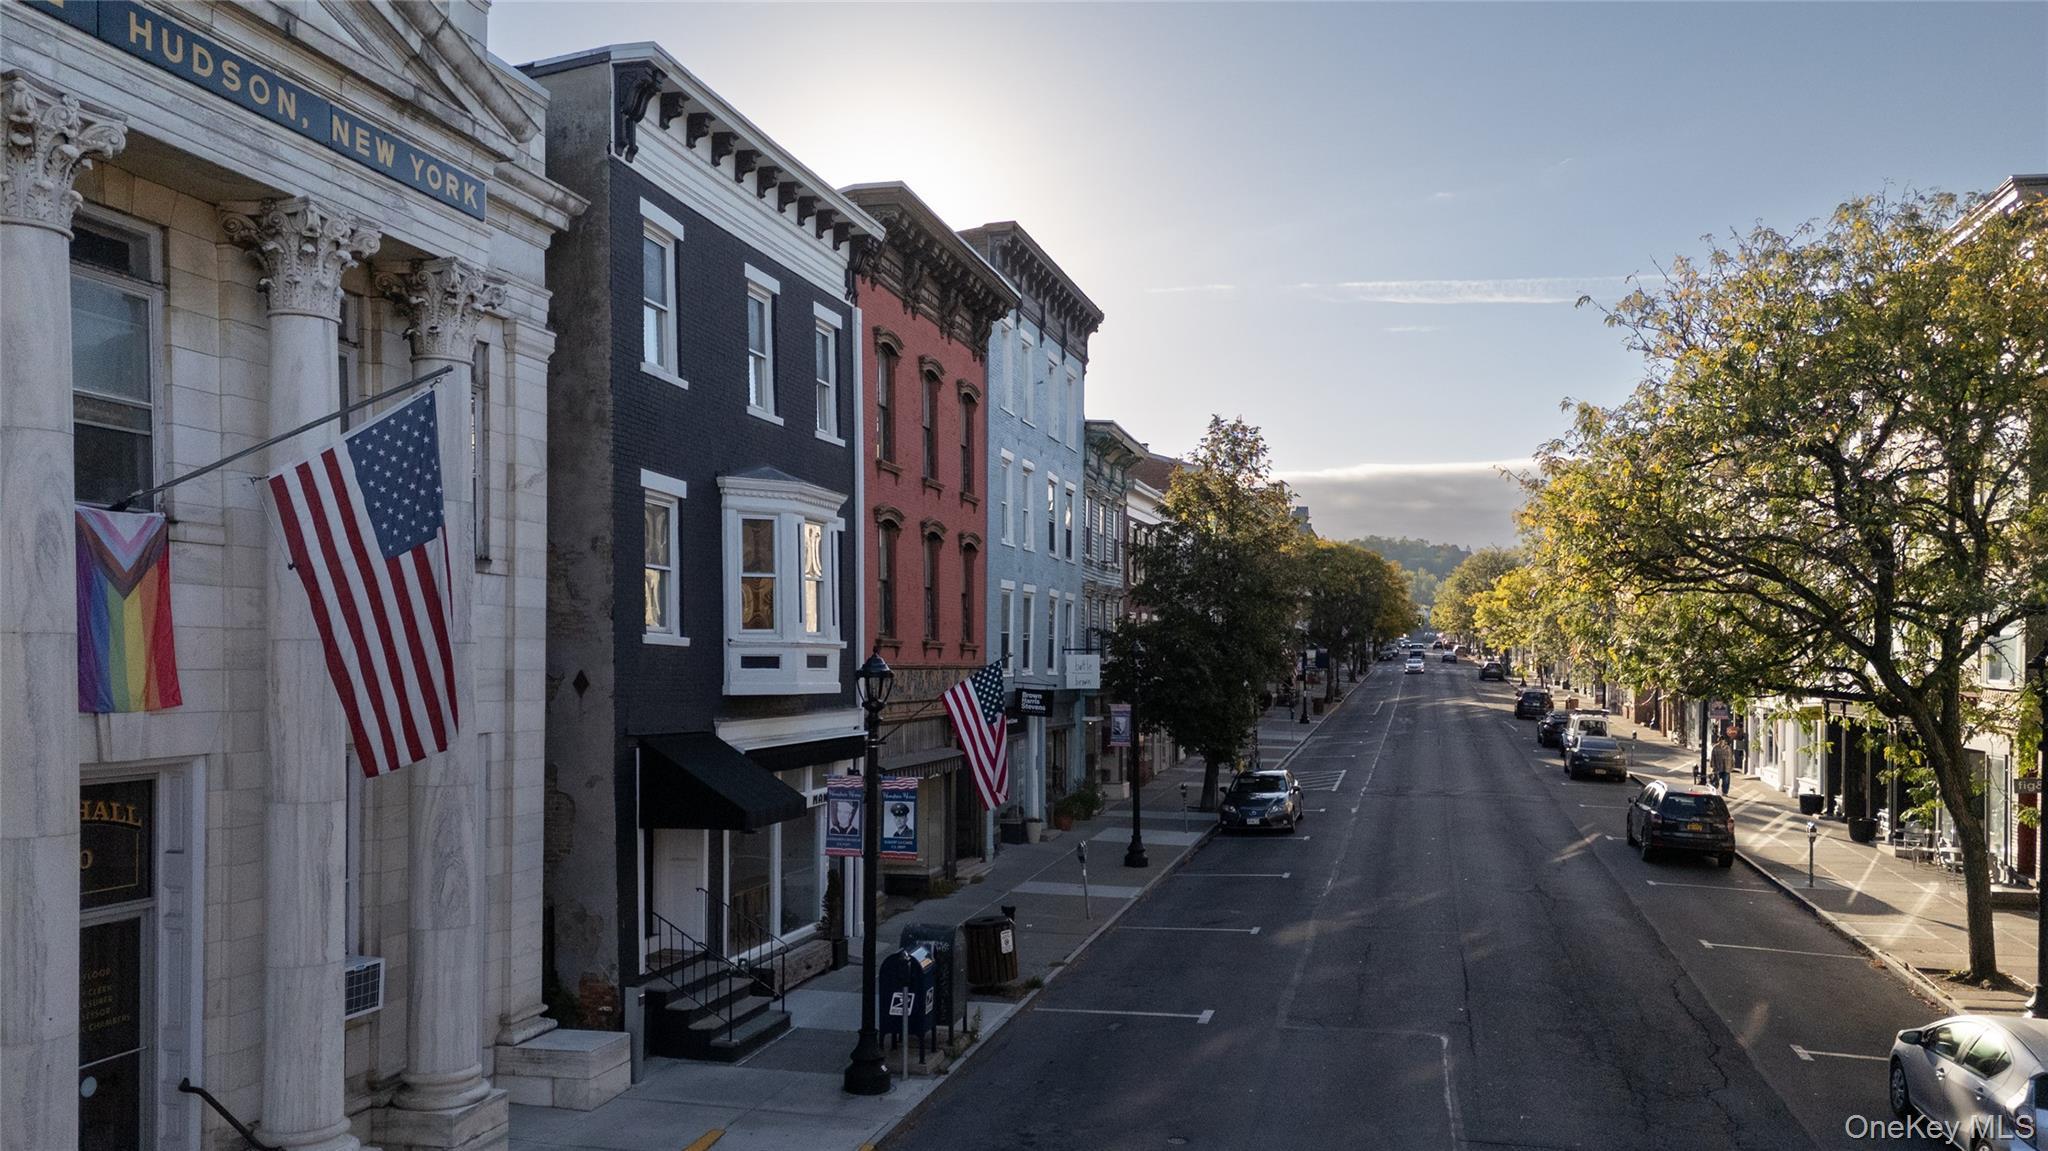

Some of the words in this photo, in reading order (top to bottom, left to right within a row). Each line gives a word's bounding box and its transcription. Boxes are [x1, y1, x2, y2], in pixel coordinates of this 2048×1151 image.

[127, 12, 310, 130] HUDSON,
[332, 114, 397, 169] NEW
[409, 153, 479, 211] YORK
[1022, 691, 1042, 699] Brown
[1021, 703, 1046, 711] Stevens
